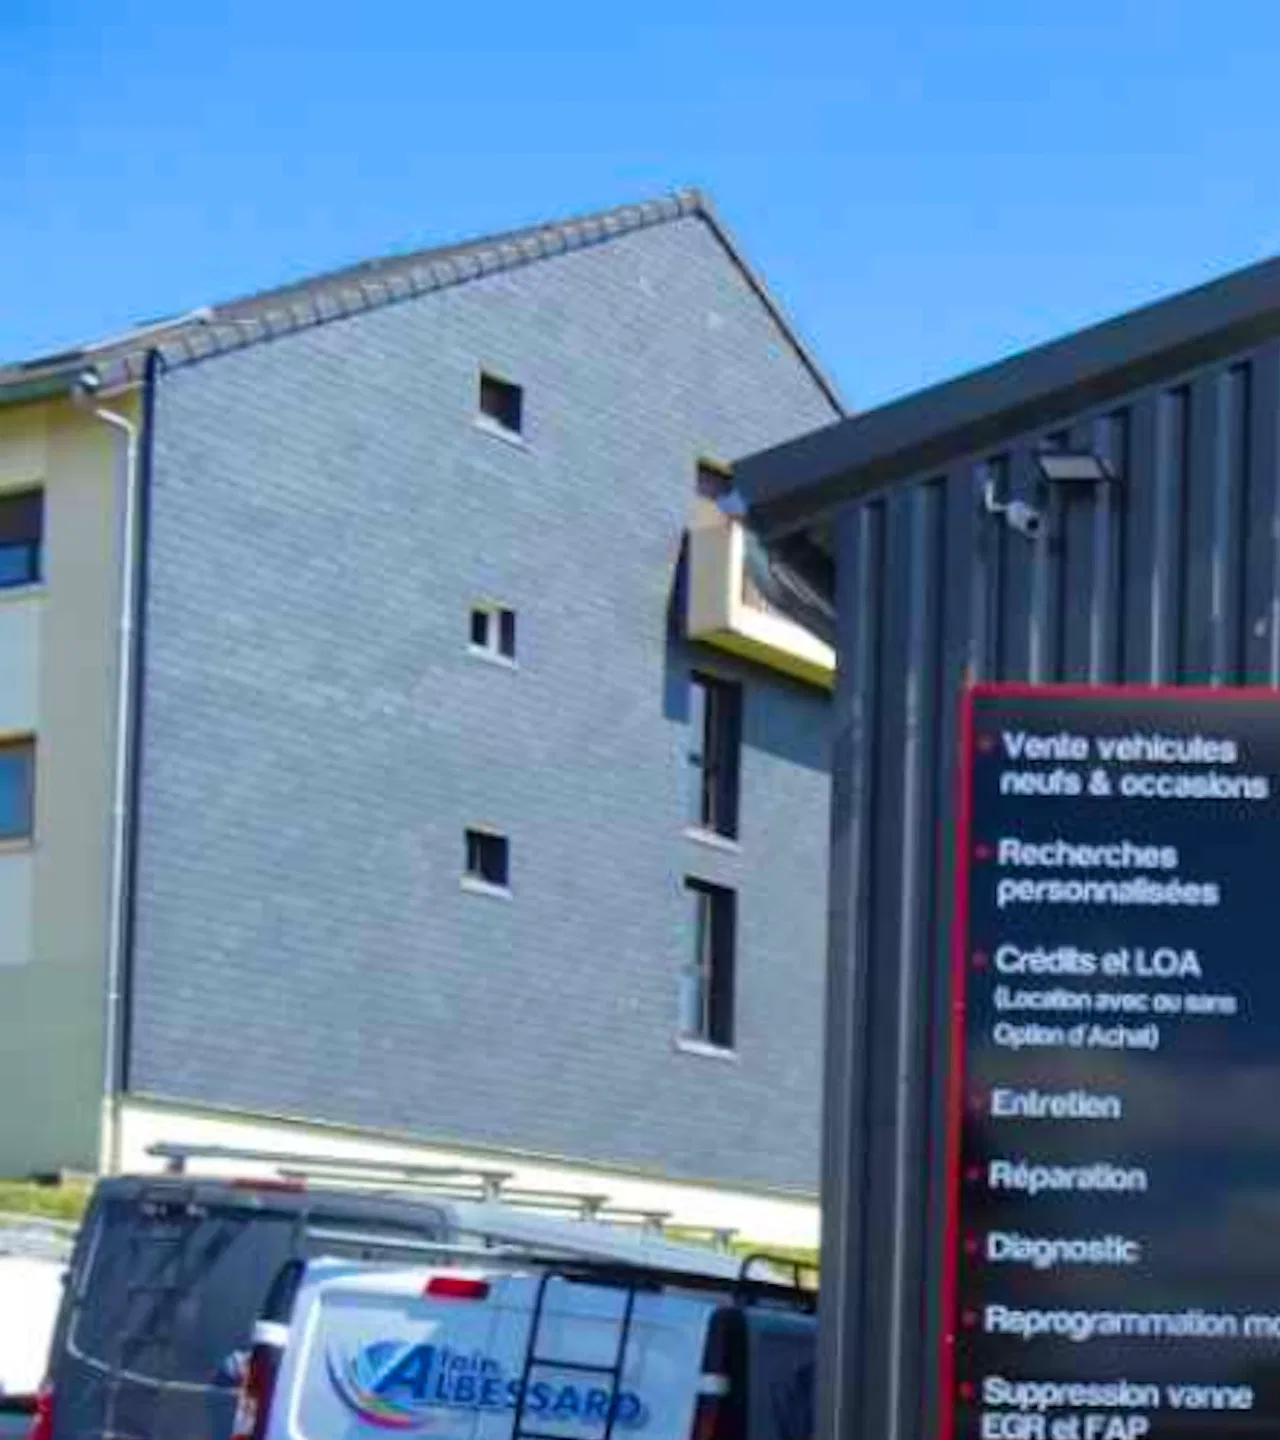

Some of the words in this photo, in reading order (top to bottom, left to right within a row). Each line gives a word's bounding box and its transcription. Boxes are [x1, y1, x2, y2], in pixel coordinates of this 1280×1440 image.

[1002, 731, 1089, 761] Vente
[999, 769, 1081, 797] neufs
[1088, 770, 1111, 796] &
[1119, 771, 1268, 800] occasions
[998, 838, 1178, 869] Recherches
[996, 876, 1220, 908] personnalisées
[995, 944, 1098, 975] Crédits
[1103, 947, 1129, 975] et
[1136, 949, 1201, 977] LOA
[993, 985, 1092, 1014] (Location
[1097, 992, 1147, 1012] avec
[1152, 993, 1181, 1012] ou
[1184, 994, 1237, 1015] sans
[993, 1023, 1065, 1050] Option
[991, 1089, 1121, 1119] Entretien
[987, 1160, 1147, 1193] Réparation
[986, 1231, 1141, 1268] Diagnostic
[984, 1305, 1237, 1342] Reprogrammation
[983, 1379, 1159, 1412] Suppression
[1167, 1384, 1253, 1410] vanne
